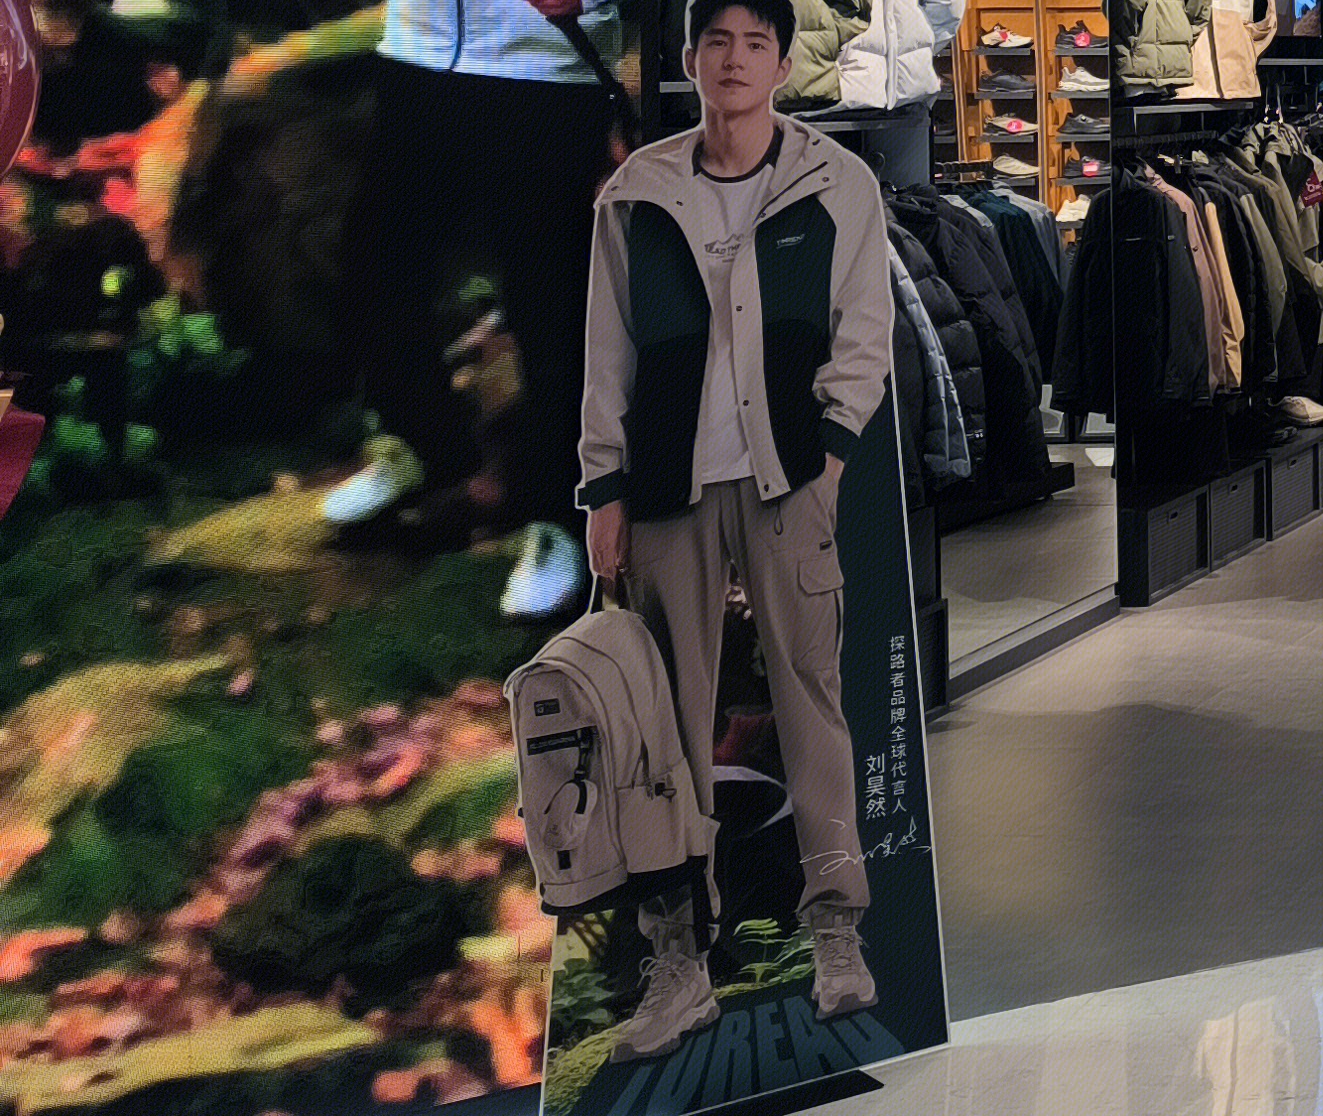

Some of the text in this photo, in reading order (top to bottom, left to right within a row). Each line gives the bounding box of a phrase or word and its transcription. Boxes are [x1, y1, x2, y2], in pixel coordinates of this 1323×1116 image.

[889, 635, 907, 814] 探路者品牌全球代言人
[864, 753, 886, 819] 刘昊然
